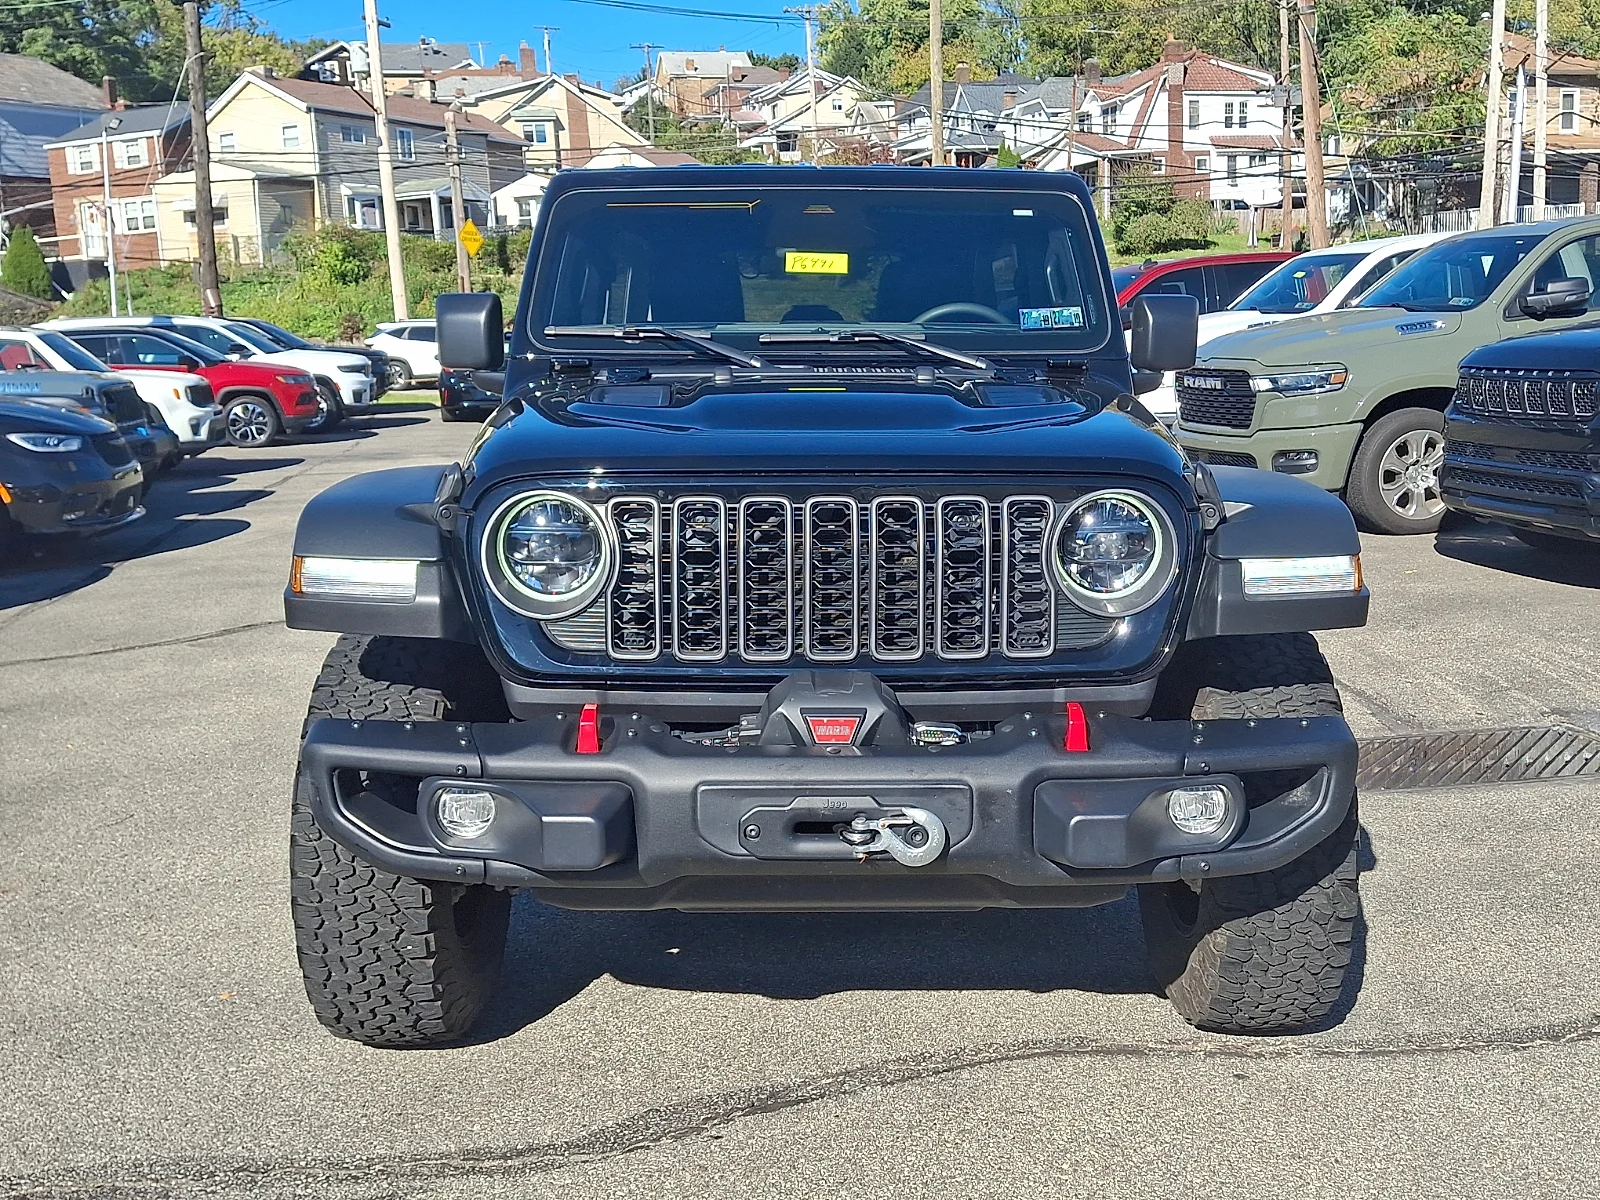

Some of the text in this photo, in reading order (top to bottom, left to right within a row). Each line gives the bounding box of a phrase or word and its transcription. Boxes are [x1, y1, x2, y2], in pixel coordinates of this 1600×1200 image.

[1183, 375, 1222, 390] RAM
[815, 725, 850, 736] WARN
[822, 798, 848, 810] Jeep
